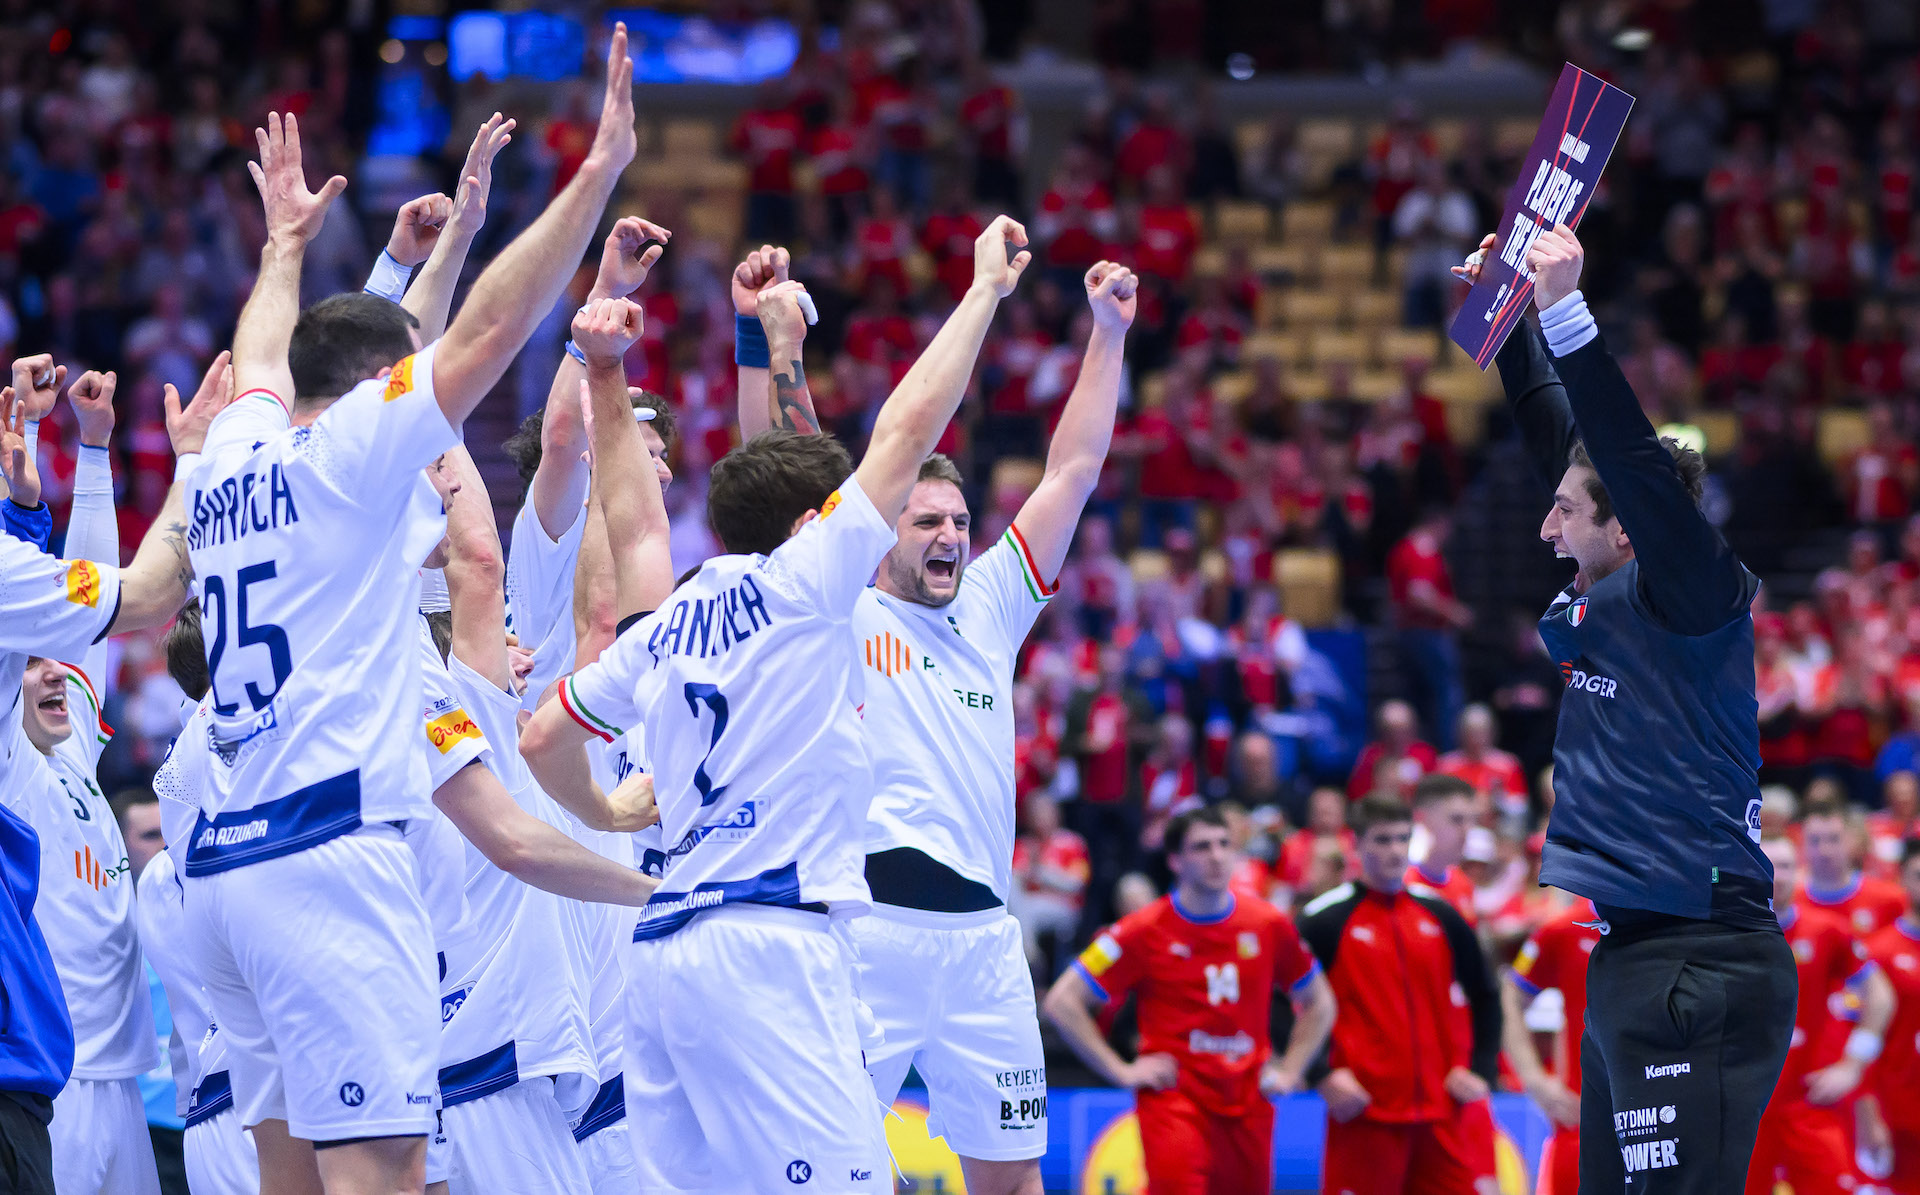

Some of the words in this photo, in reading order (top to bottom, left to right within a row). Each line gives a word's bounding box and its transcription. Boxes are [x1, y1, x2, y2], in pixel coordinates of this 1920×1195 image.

[1524, 158, 1573, 224] PLAYER
[1555, 178, 1585, 225] OF
[1500, 211, 1535, 267] THE
[203, 559, 293, 716] 25
[683, 682, 729, 807] 2
[995, 1068, 1038, 1088] KEYJEY
[1645, 1062, 1691, 1079] Kempa
[1621, 1140, 1679, 1173] OWER
